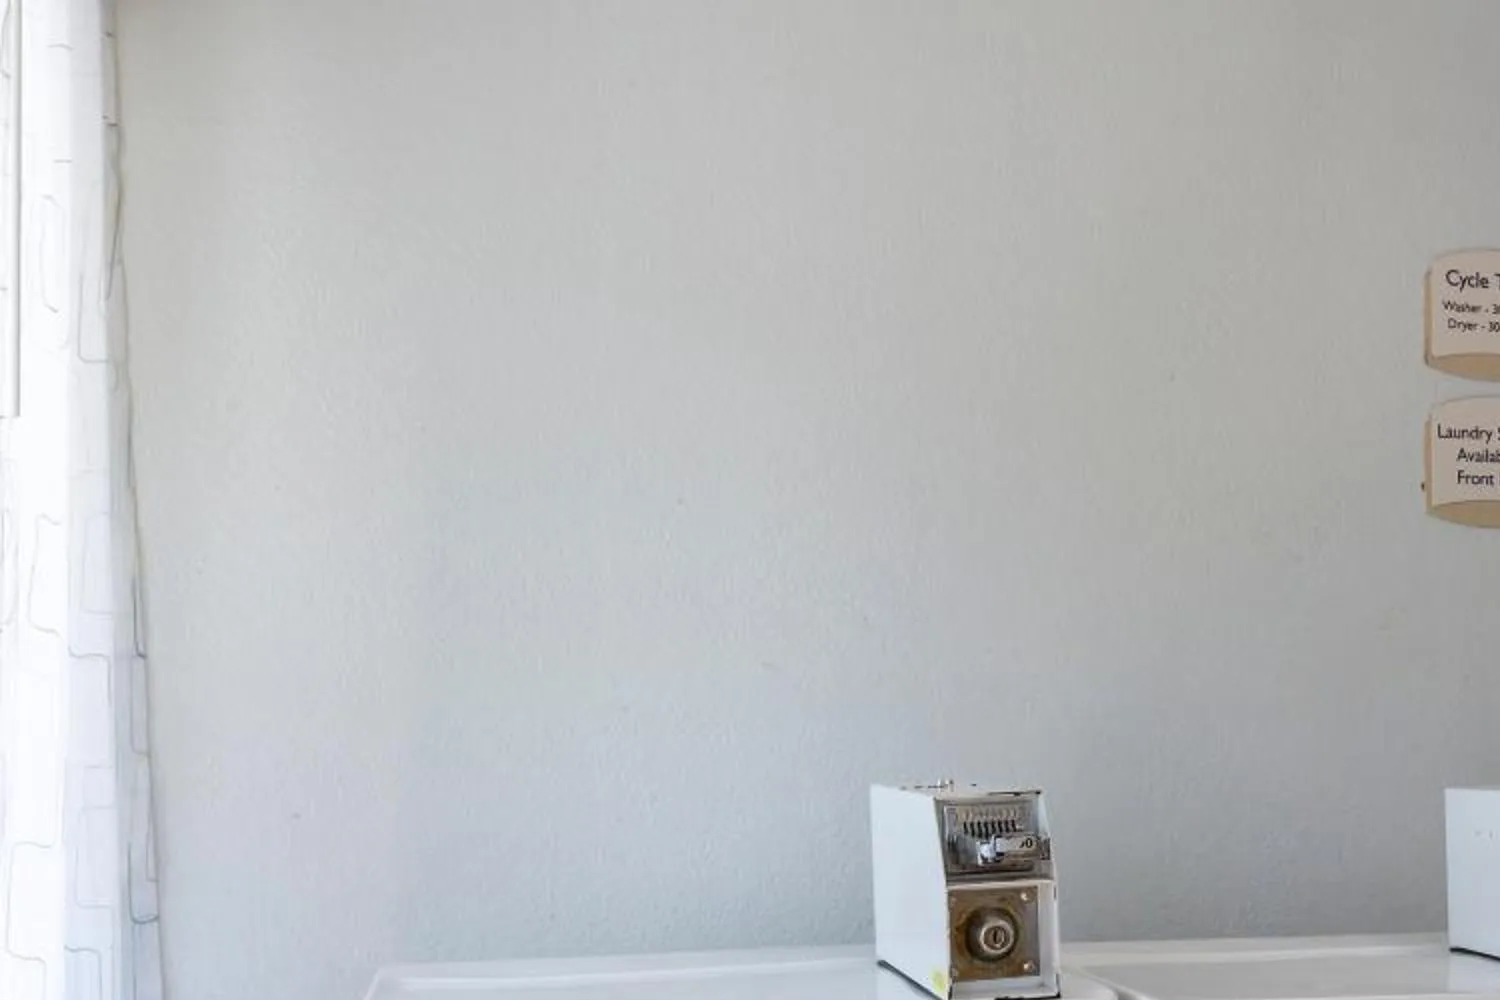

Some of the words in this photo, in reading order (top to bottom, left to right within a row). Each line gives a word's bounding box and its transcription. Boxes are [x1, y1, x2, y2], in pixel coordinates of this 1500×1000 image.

[1445, 269, 1489, 293] Cycle
[1442, 301, 1482, 314] Washer
[1447, 318, 1478, 333] Dryer
[1488, 321, 1500, 333] 30
[1437, 423, 1493, 444] Laundry
[1456, 470, 1495, 486] Front
